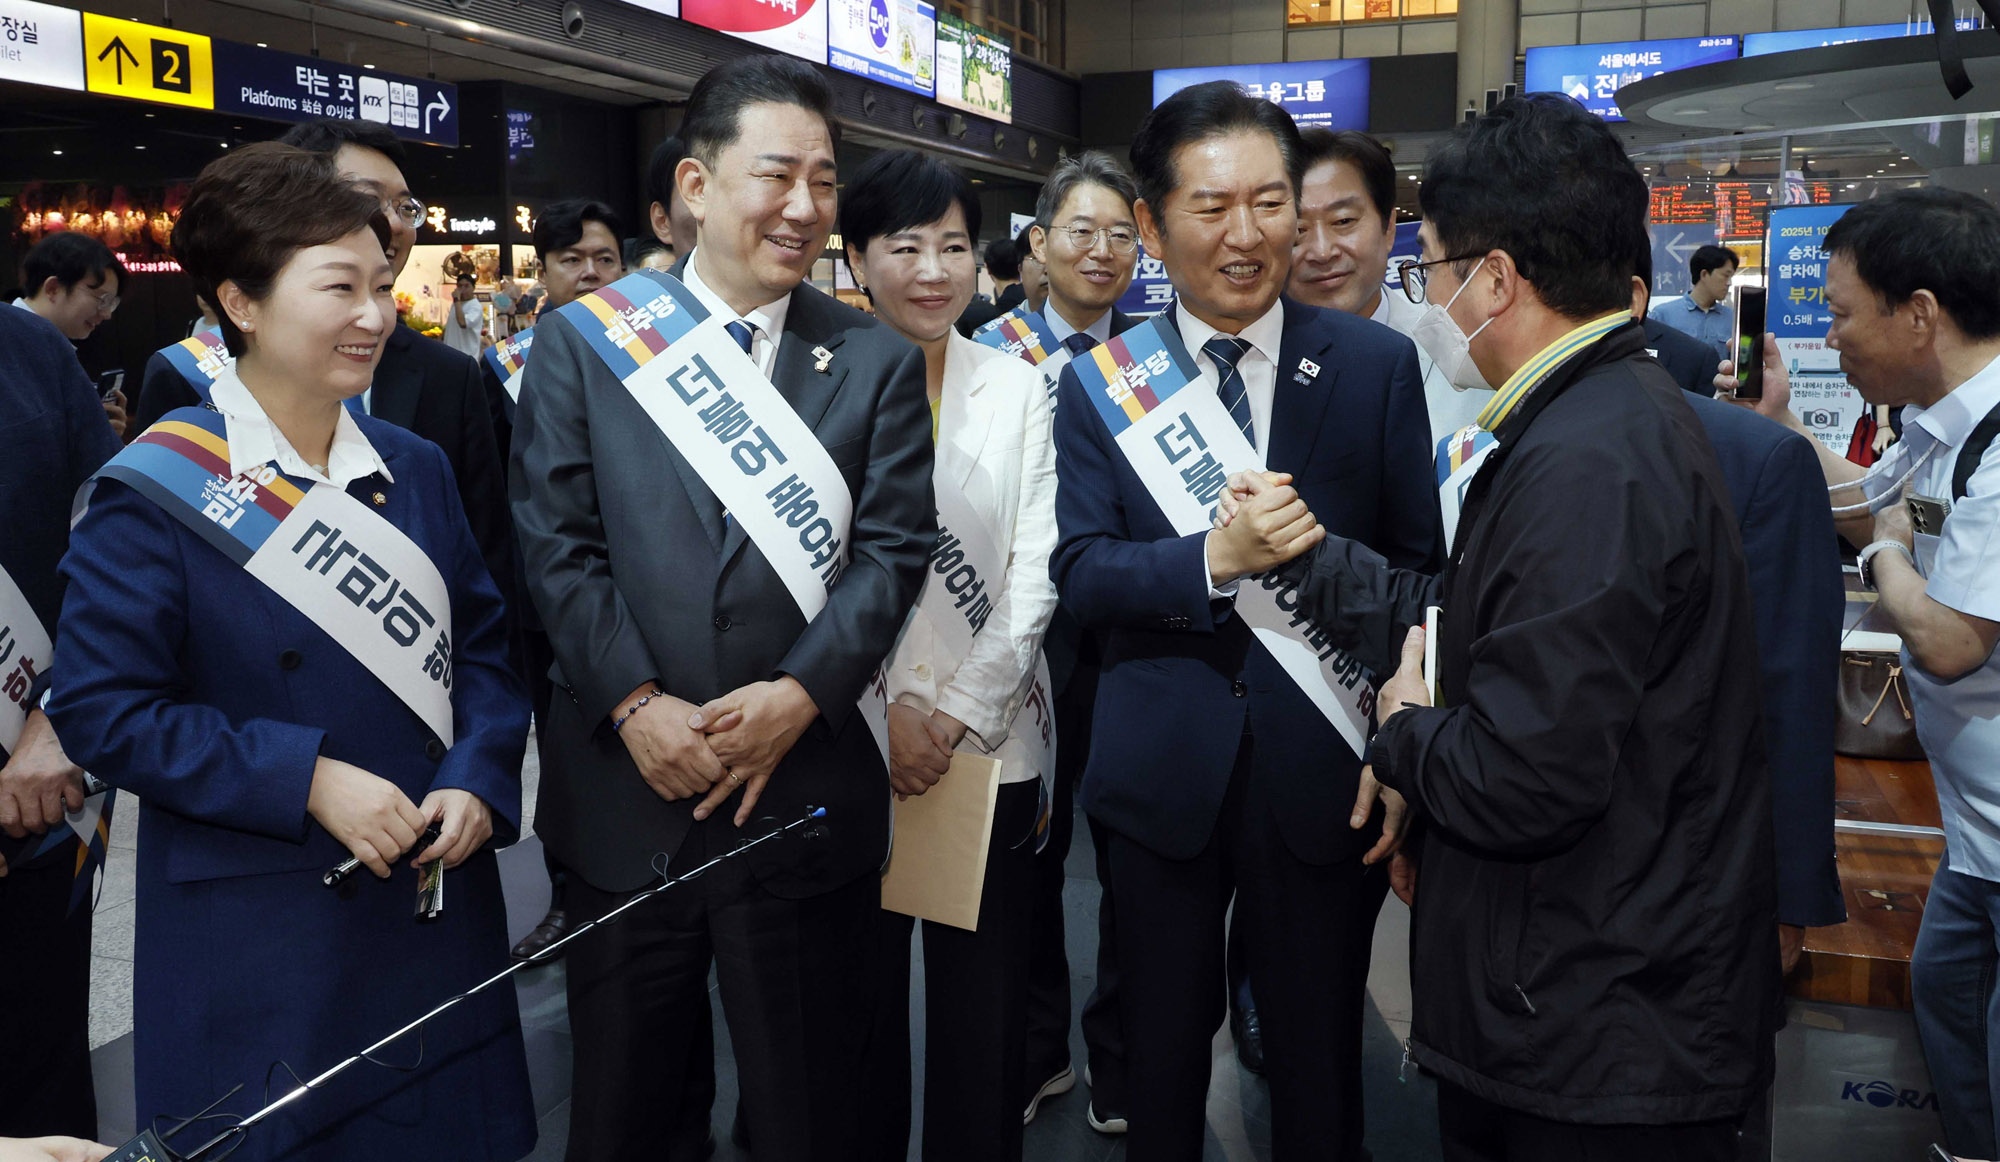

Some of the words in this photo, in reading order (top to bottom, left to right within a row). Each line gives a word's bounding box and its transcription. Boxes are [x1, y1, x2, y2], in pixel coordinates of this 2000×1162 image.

[0, 15, 38, 45] 장실
[0, 45, 22, 62] ilet
[1598, 52, 1662, 69] 서울에서도
[163, 52, 181, 84] 2
[295, 66, 330, 97] 타는
[338, 73, 355, 103] 곳
[240, 86, 297, 111] Platforms
[301, 98, 322, 116] 站台
[362, 95, 387, 108] KTX
[325, 104, 355, 120] のりば
[1780, 226, 1813, 236] 2025년
[1816, 224, 1832, 236] 10
[1778, 263, 1821, 279] 열차에
[1788, 286, 1831, 305] 부가
[603, 294, 676, 350] 민주당
[1783, 314, 1813, 325] 0.5배
[1104, 348, 1172, 406] 민주당
[666, 353, 788, 477] 더불어
[1153, 411, 1227, 528] 더불
[291, 518, 437, 648] 국민이
